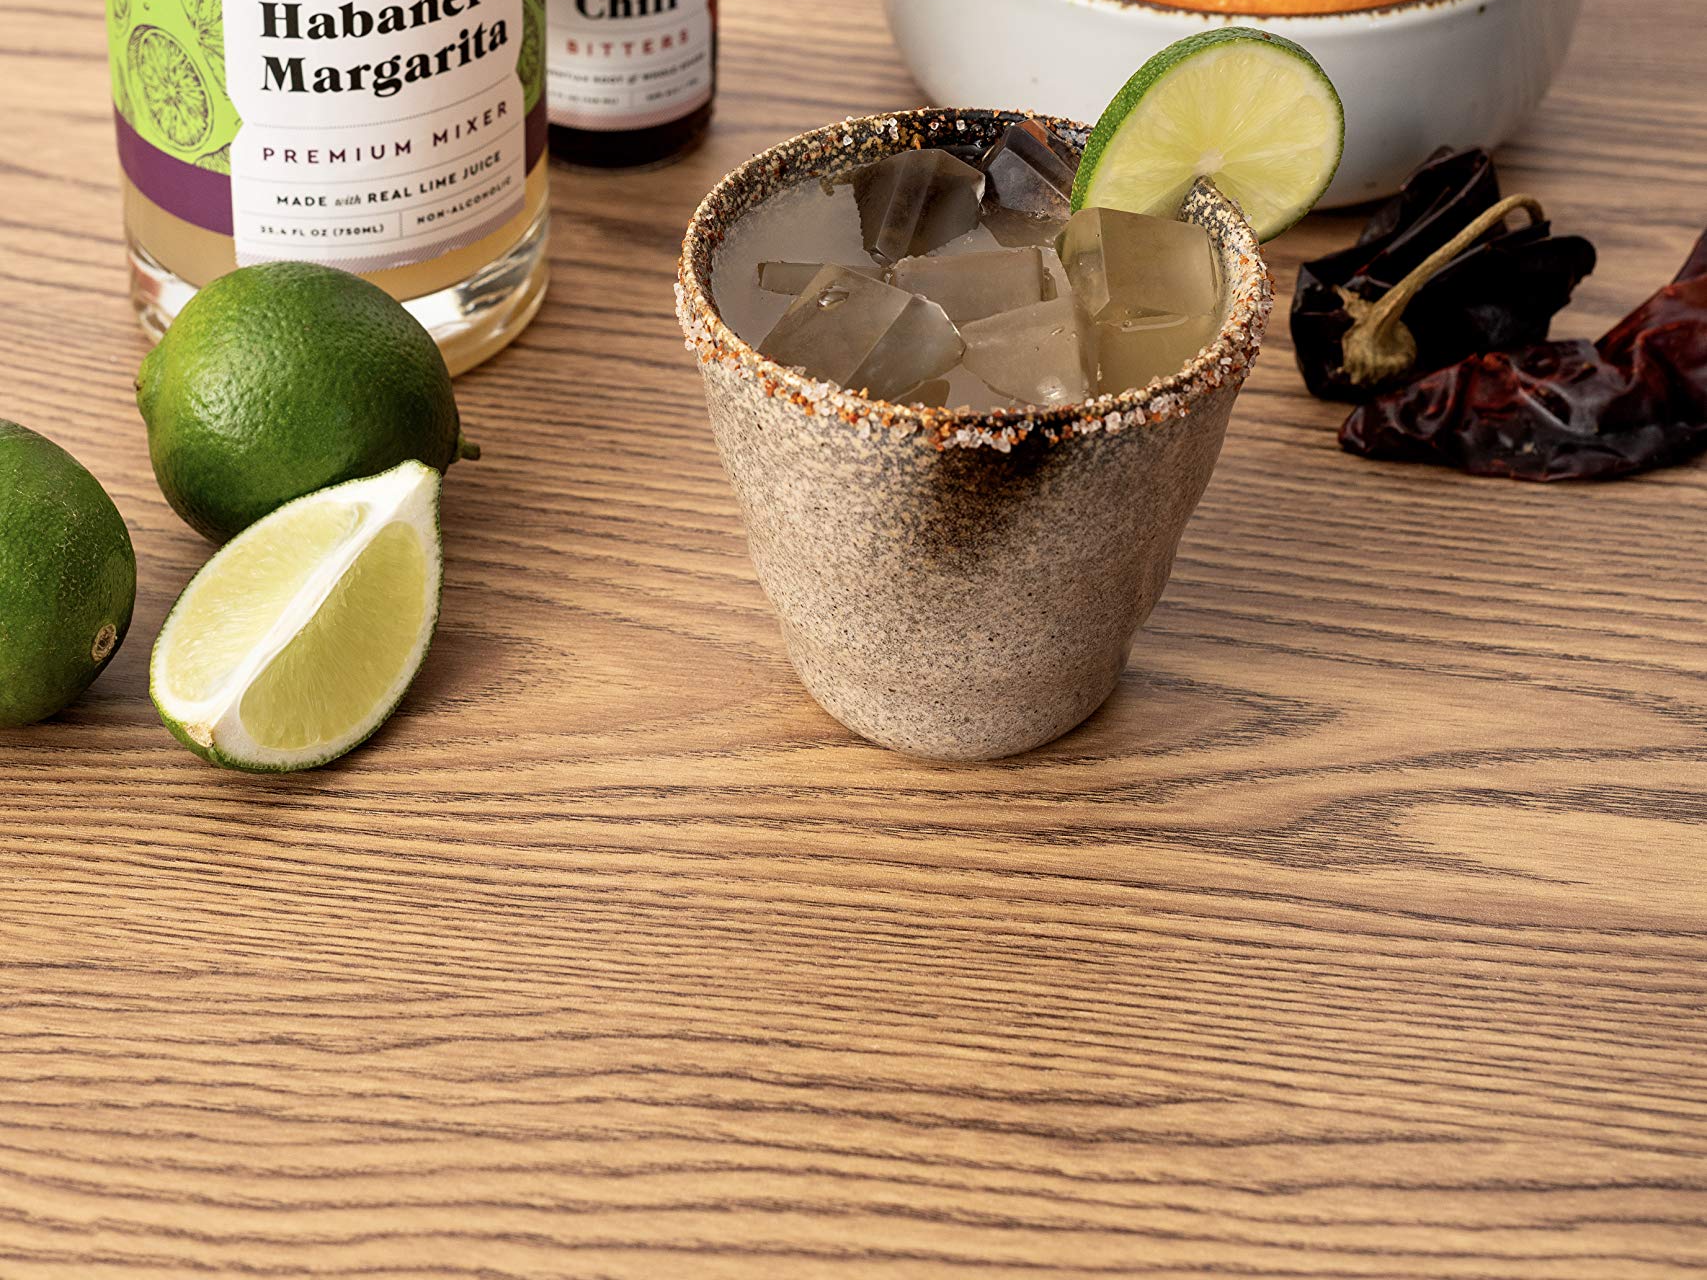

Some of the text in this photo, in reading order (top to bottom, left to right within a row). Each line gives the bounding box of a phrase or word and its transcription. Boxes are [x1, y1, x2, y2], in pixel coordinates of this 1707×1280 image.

[260, 19, 508, 98] Margarita
[566, 28, 688, 57] BITTERS
[262, 101, 508, 165] PREMIUM MIXER
[276, 150, 502, 208] MADE with REAL LIME JUICE
[416, 175, 512, 225] NON-ALCOHOLIC
[310, 227, 328, 237] OZ
